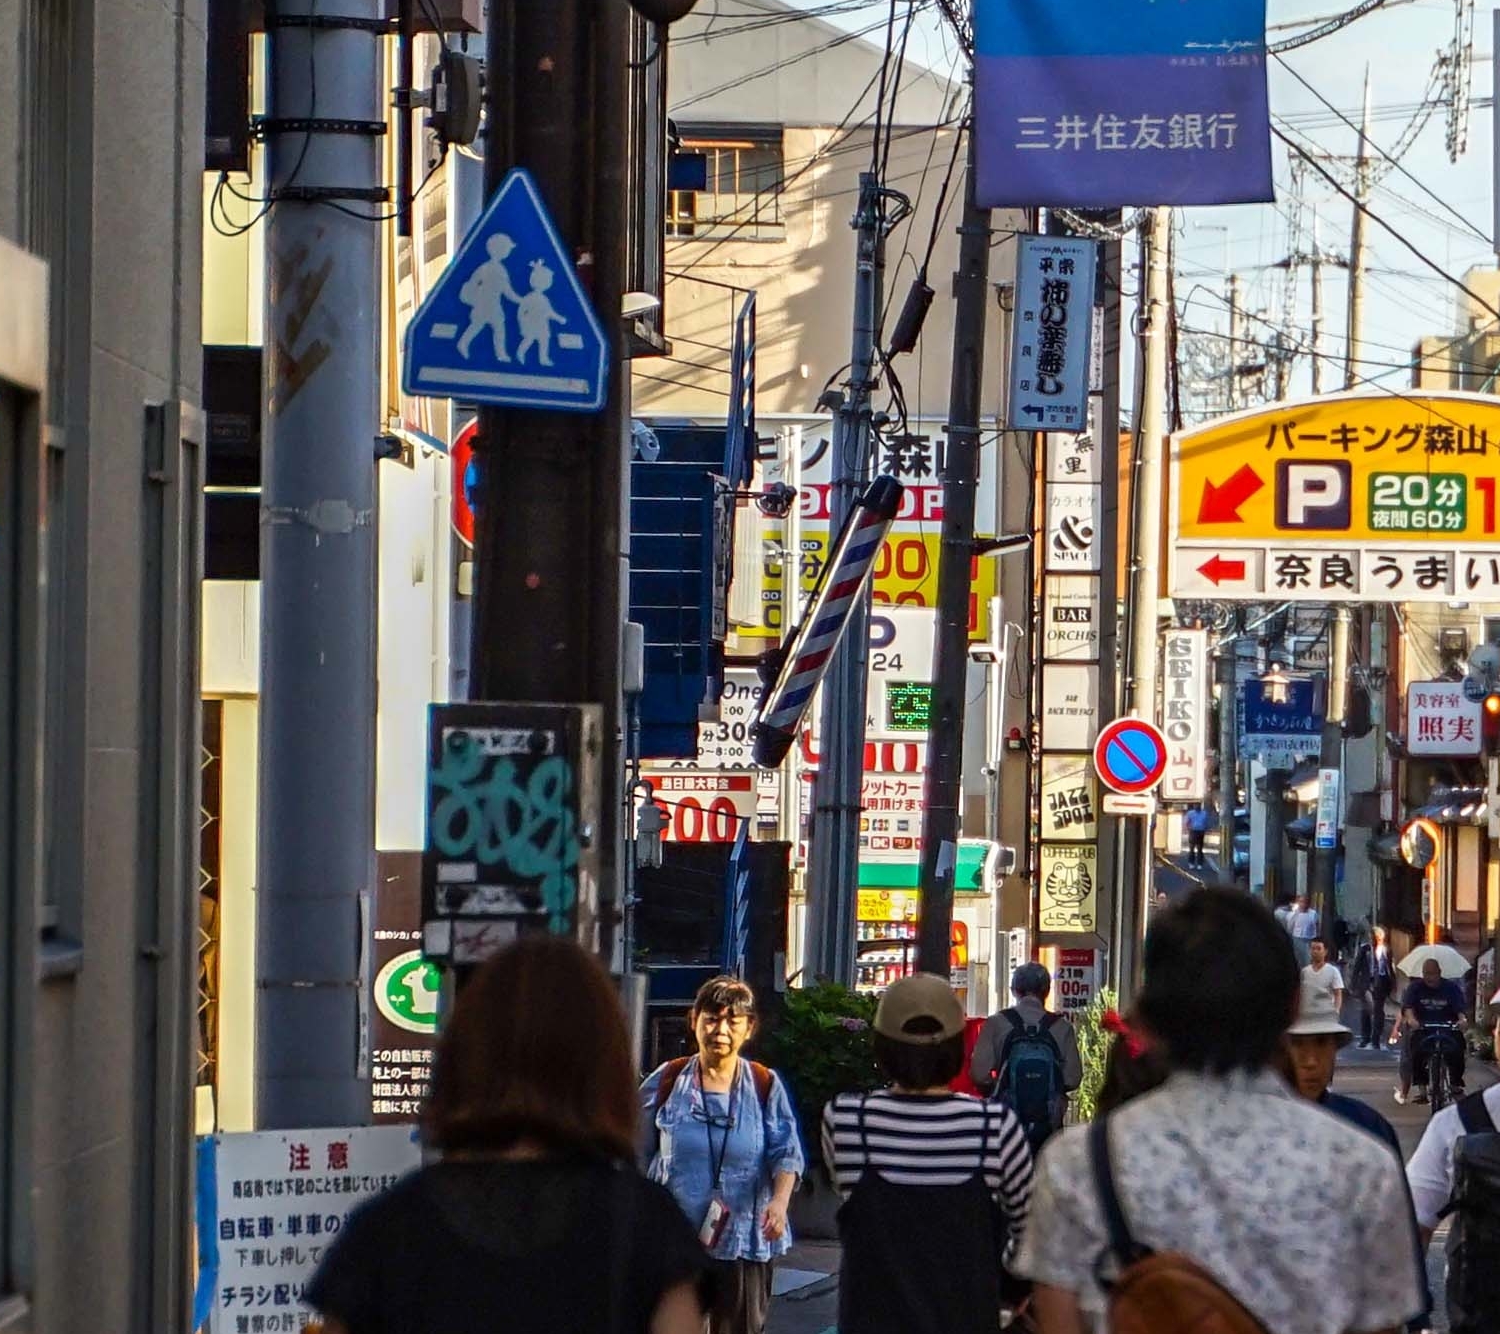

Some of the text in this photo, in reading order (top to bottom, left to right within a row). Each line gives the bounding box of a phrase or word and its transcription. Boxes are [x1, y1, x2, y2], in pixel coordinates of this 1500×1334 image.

[1016, 113, 1238, 151] 三井住友銀行
[1264, 423, 1487, 456] パーキング森山
[1051, 495, 1096, 508] カラオケ
[1287, 463, 1343, 525] P
[1373, 475, 1462, 507] 20分
[1372, 510, 1463, 530] 夜間60分
[1056, 608, 1089, 621] BAR
[1047, 629, 1097, 641] ORCHIS
[1167, 636, 1193, 742] SEIKO
[1414, 693, 1460, 708] 美容室
[1417, 715, 1475, 742] 照実
[1171, 748, 1193, 791] 山口
[1046, 786, 1088, 812] JAZZ
[1051, 803, 1094, 831] SPOT
[289, 1142, 348, 1171] 注意
[221, 1283, 306, 1307] チラシ配り
